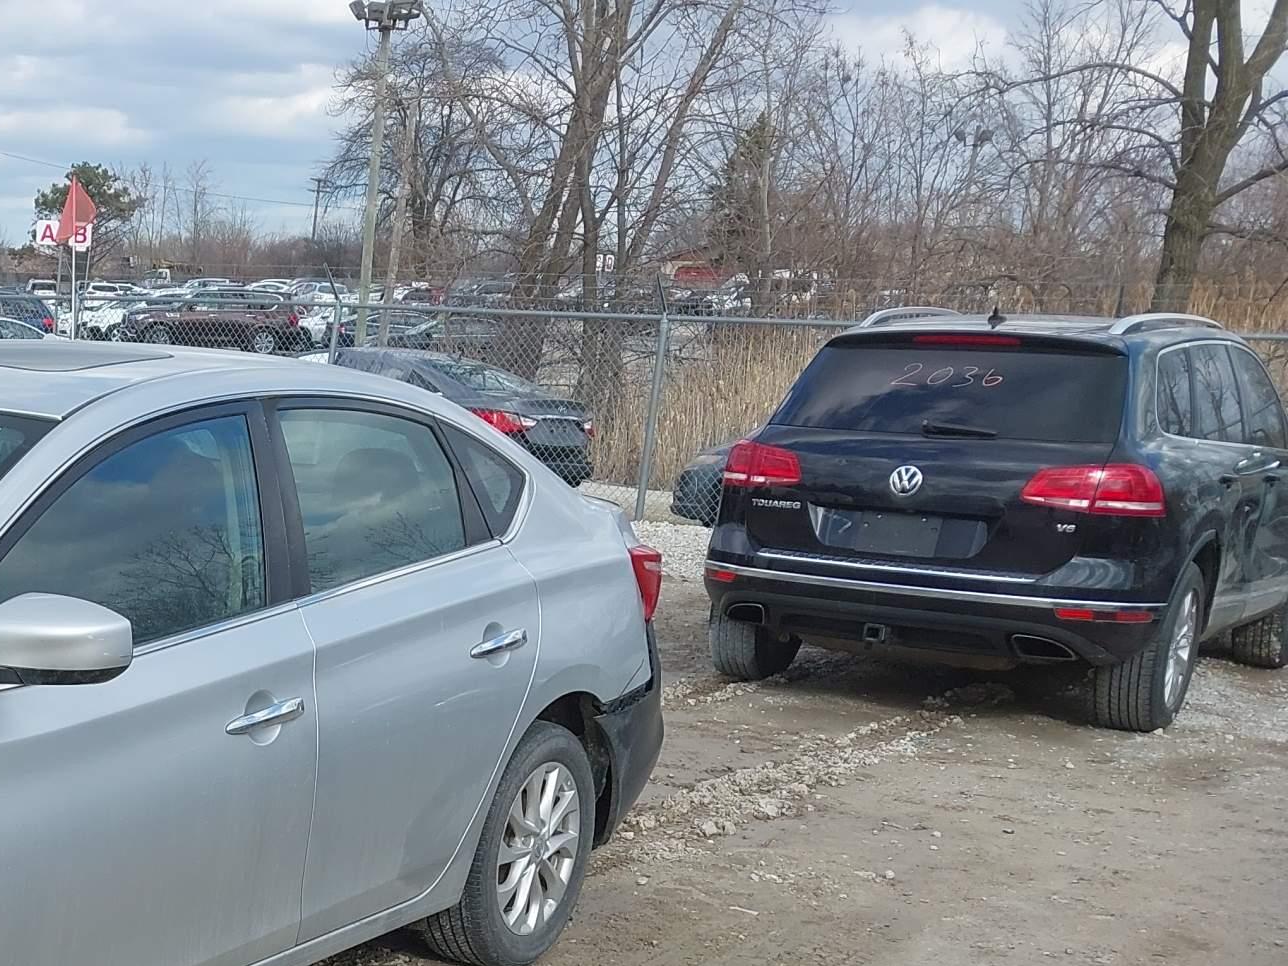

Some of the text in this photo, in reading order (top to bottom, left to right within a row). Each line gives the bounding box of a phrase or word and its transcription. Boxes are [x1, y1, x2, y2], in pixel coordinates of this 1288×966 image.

[40, 223, 56, 242] A
[74, 224, 87, 244] B
[890, 362, 1003, 388] 2036
[751, 498, 802, 510] TOUAREG
[1056, 523, 1077, 533] V6
